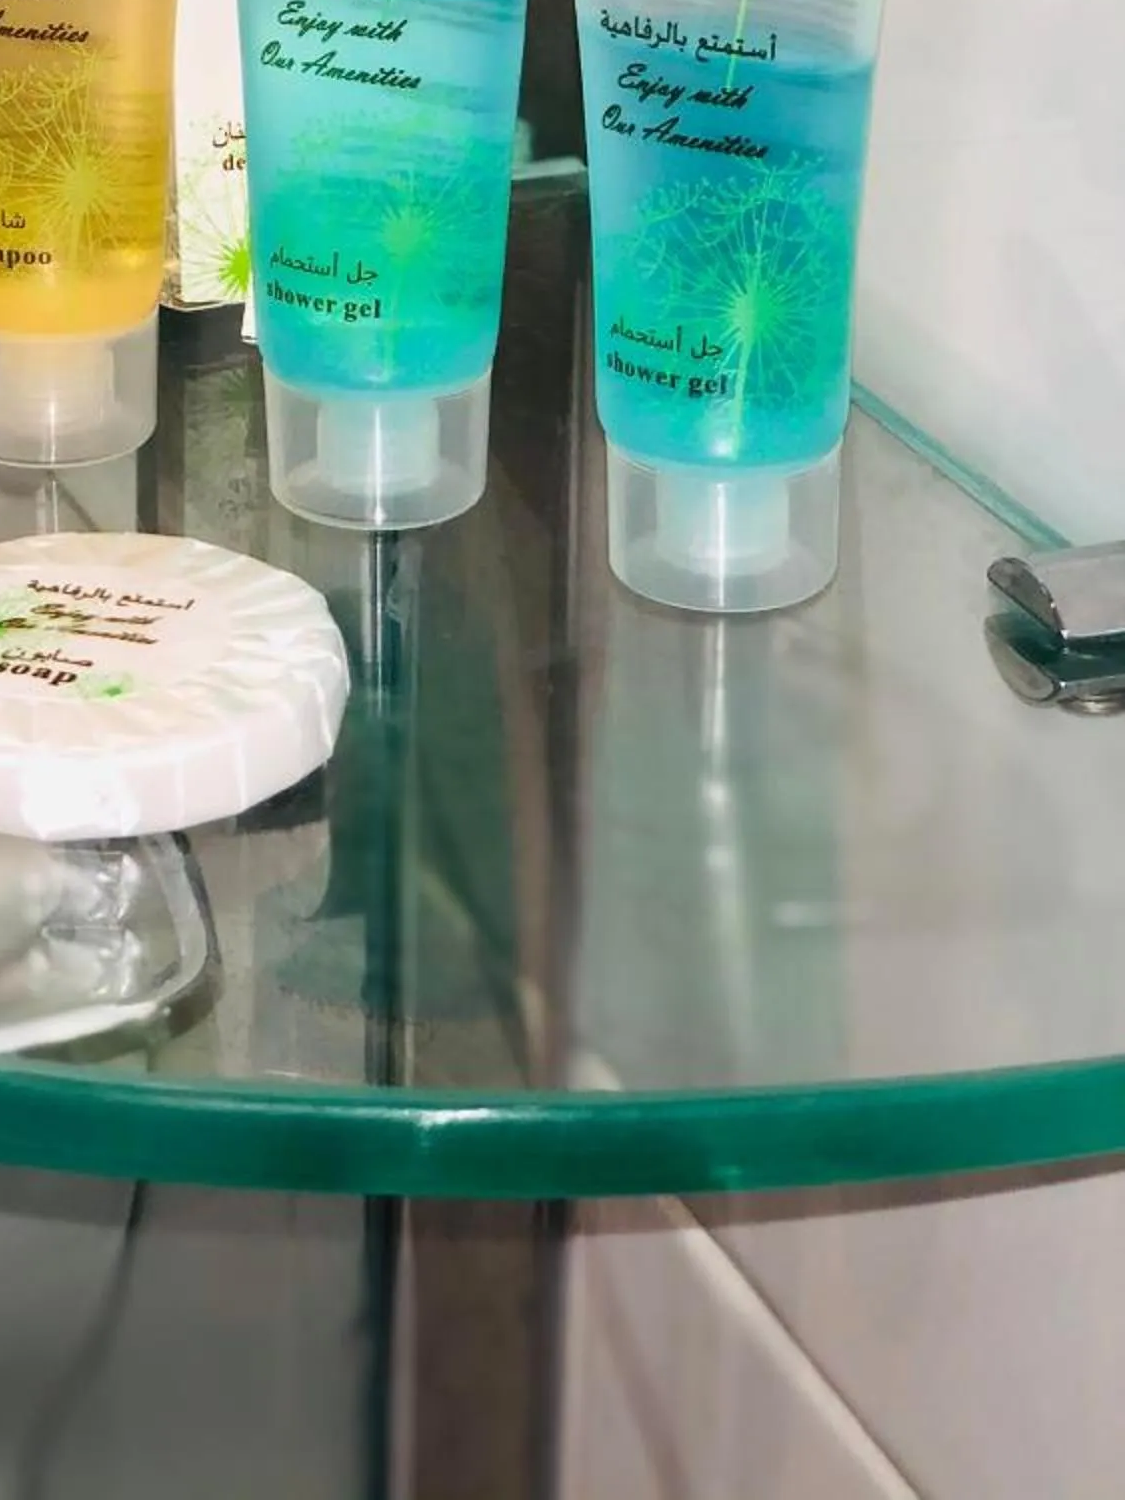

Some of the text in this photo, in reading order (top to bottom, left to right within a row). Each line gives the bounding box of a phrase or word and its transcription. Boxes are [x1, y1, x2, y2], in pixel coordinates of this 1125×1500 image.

[277, 0, 409, 43] Enjoy with
[600, 9, 688, 54] بالرفاهية
[259, 40, 423, 91] Our Amenities
[617, 62, 755, 111] Enjoy with
[601, 104, 771, 160] Our Amenities
[346, 259, 379, 287] جل
[266, 280, 381, 322] shower gel
[690, 332, 723, 362] جل
[606, 351, 728, 398] shower gel
